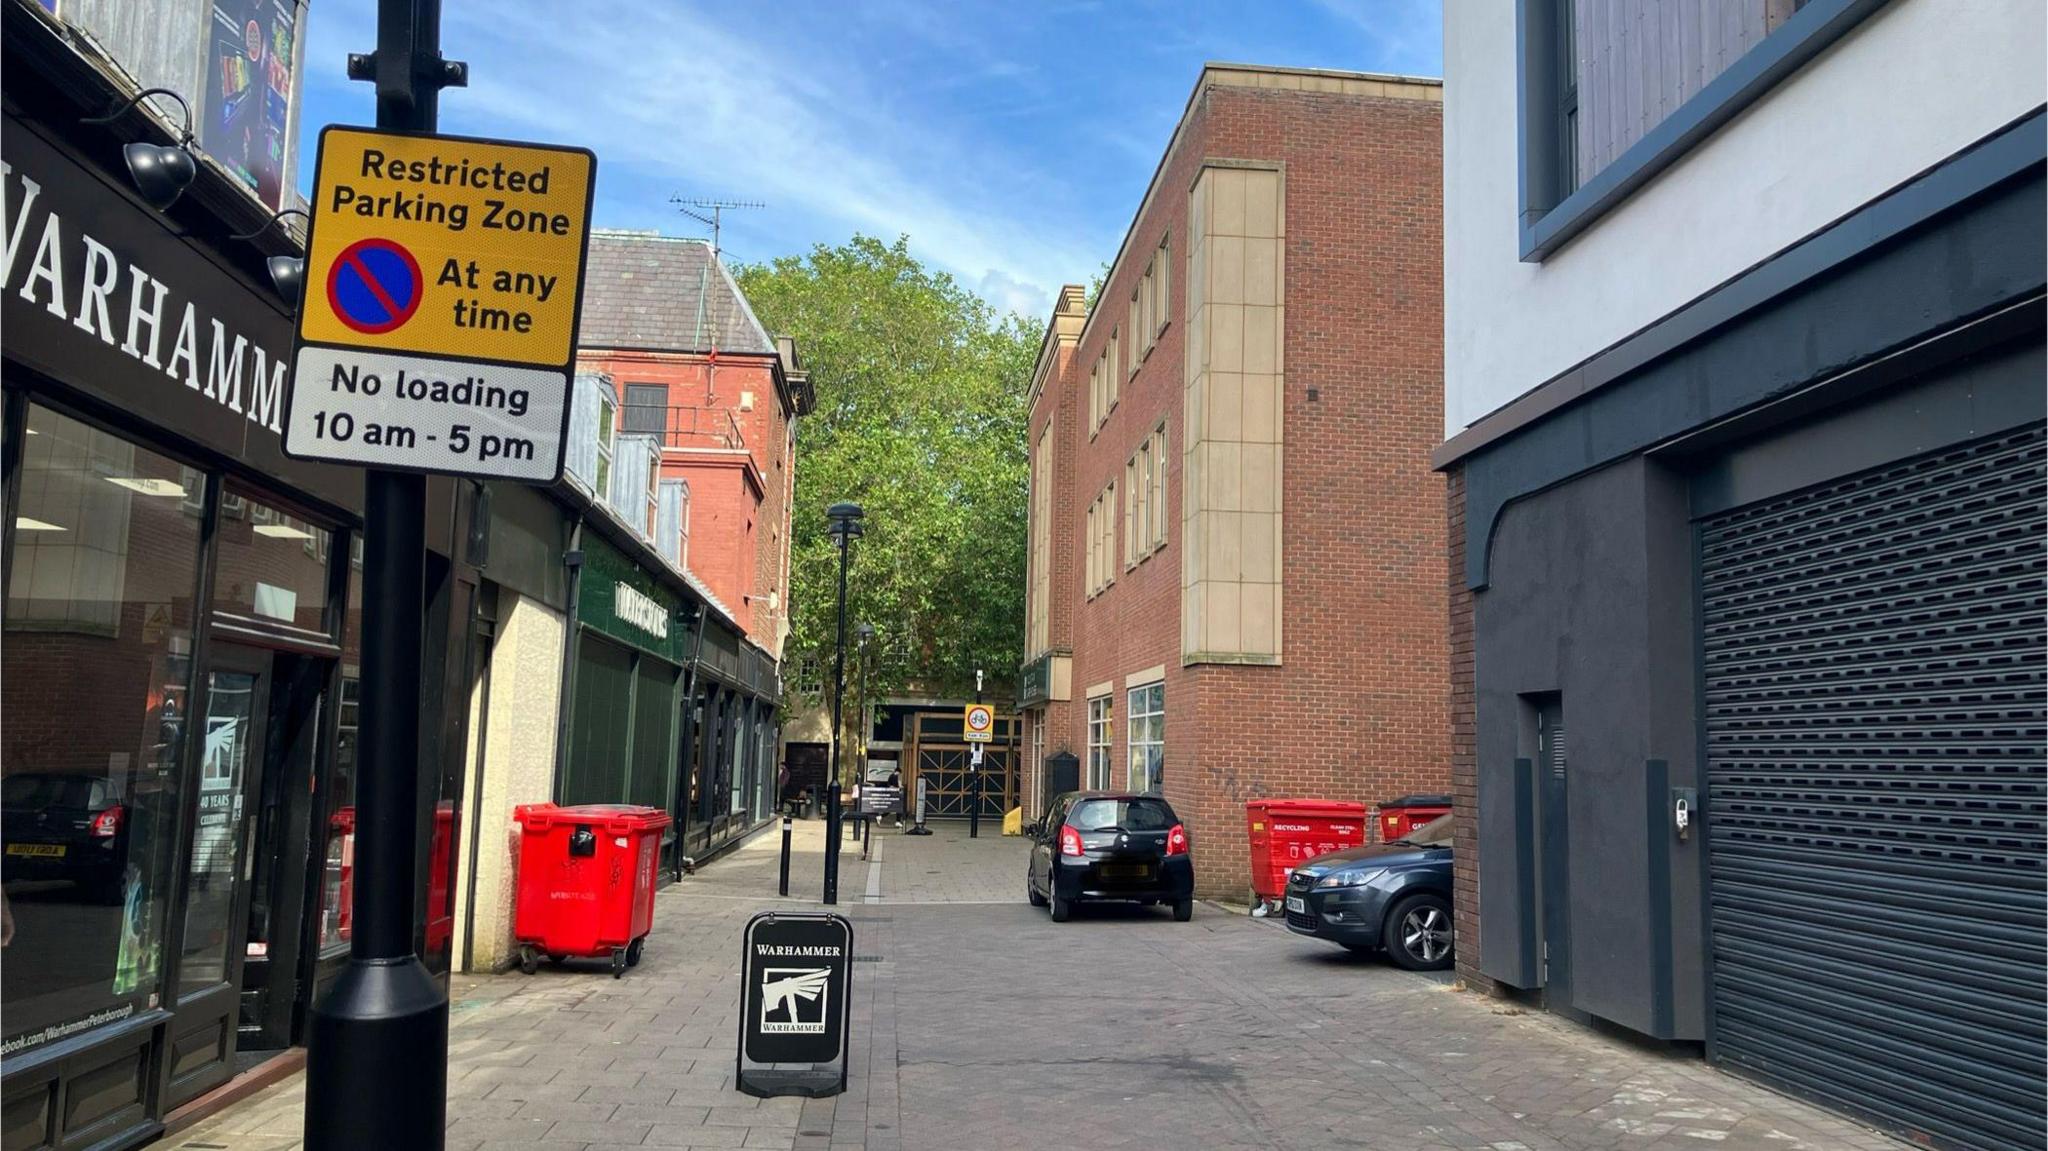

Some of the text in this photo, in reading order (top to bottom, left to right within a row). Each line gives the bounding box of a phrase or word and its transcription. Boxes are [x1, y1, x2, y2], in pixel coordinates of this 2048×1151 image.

[361, 149, 550, 195] Restricted
[332, 185, 570, 236] Parking Zone
[437, 258, 558, 303] At any
[453, 298, 533, 334] time
[331, 363, 530, 417] No loading
[313, 410, 354, 442] 10
[363, 423, 416, 449] am
[448, 424, 471, 454] 5
[478, 434, 534, 462] pm
[1273, 823, 1310, 832] RECYCLING
[756, 944, 840, 956] WARHAMMER
[763, 1023, 824, 1032] WARHAMMER
